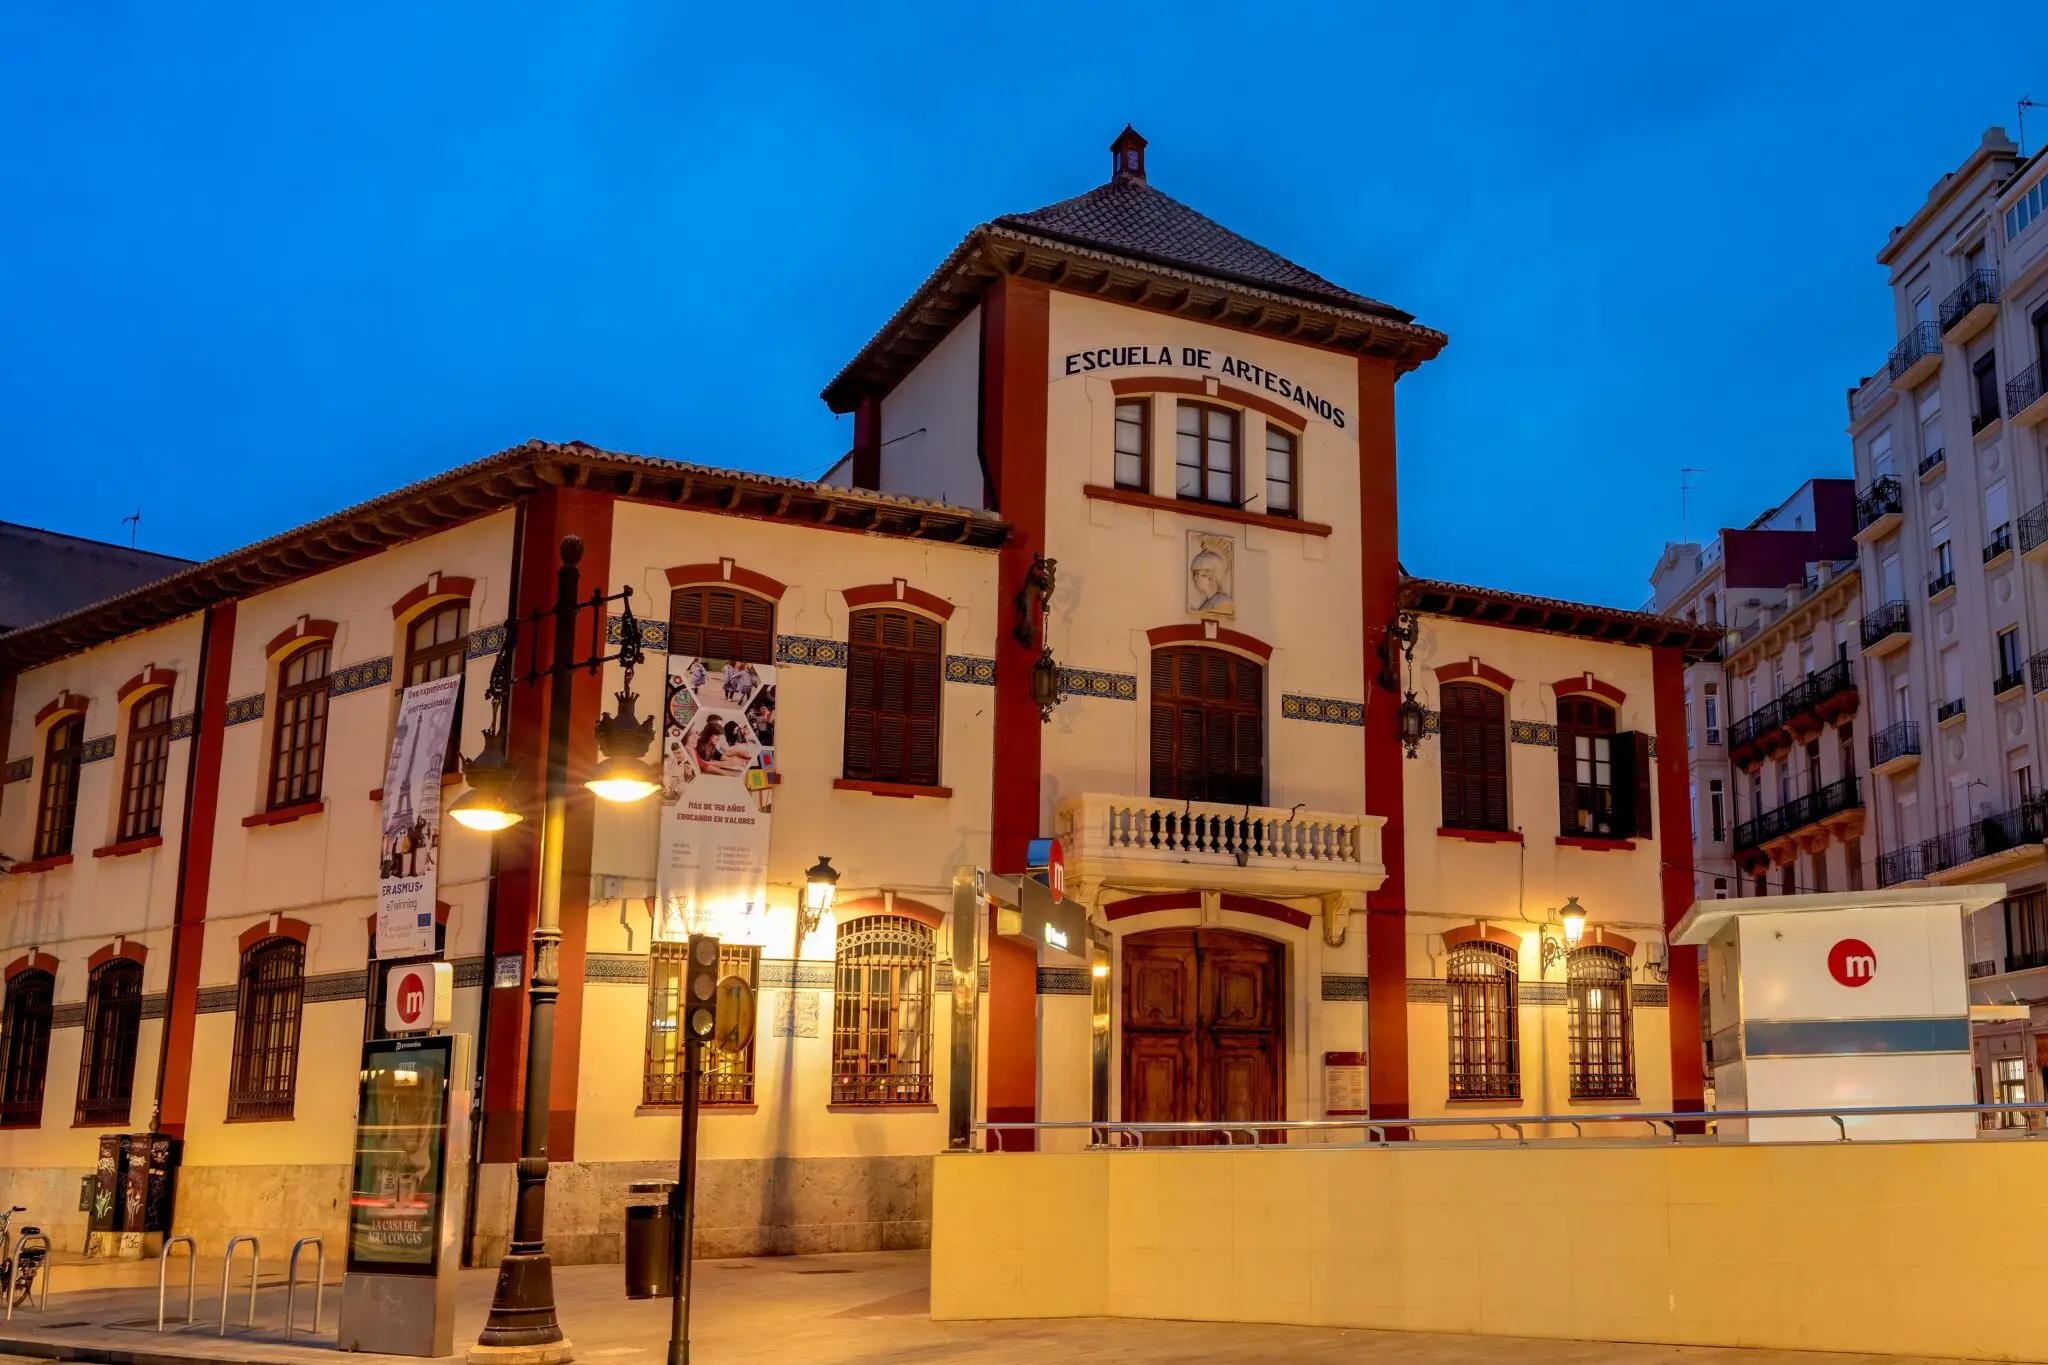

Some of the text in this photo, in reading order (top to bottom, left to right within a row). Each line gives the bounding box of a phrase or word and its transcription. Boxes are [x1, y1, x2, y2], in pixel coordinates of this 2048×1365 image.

[1065, 346, 1346, 429] ESCUELA DE ARTESANOS
[419, 680, 458, 696] experiencias
[688, 801, 746, 813] MÁS DE 150 AÑOS
[676, 813, 756, 825] EDUCANDO EN VALORES
[382, 881, 424, 896] ERASMUS+
[386, 898, 418, 912] eTwinning
[1845, 955, 1875, 978] m
[406, 991, 424, 1014] m
[372, 1219, 419, 1232] LA CASA DEL
[388, 1231, 406, 1244] CON
[406, 1232, 422, 1244] GAS
